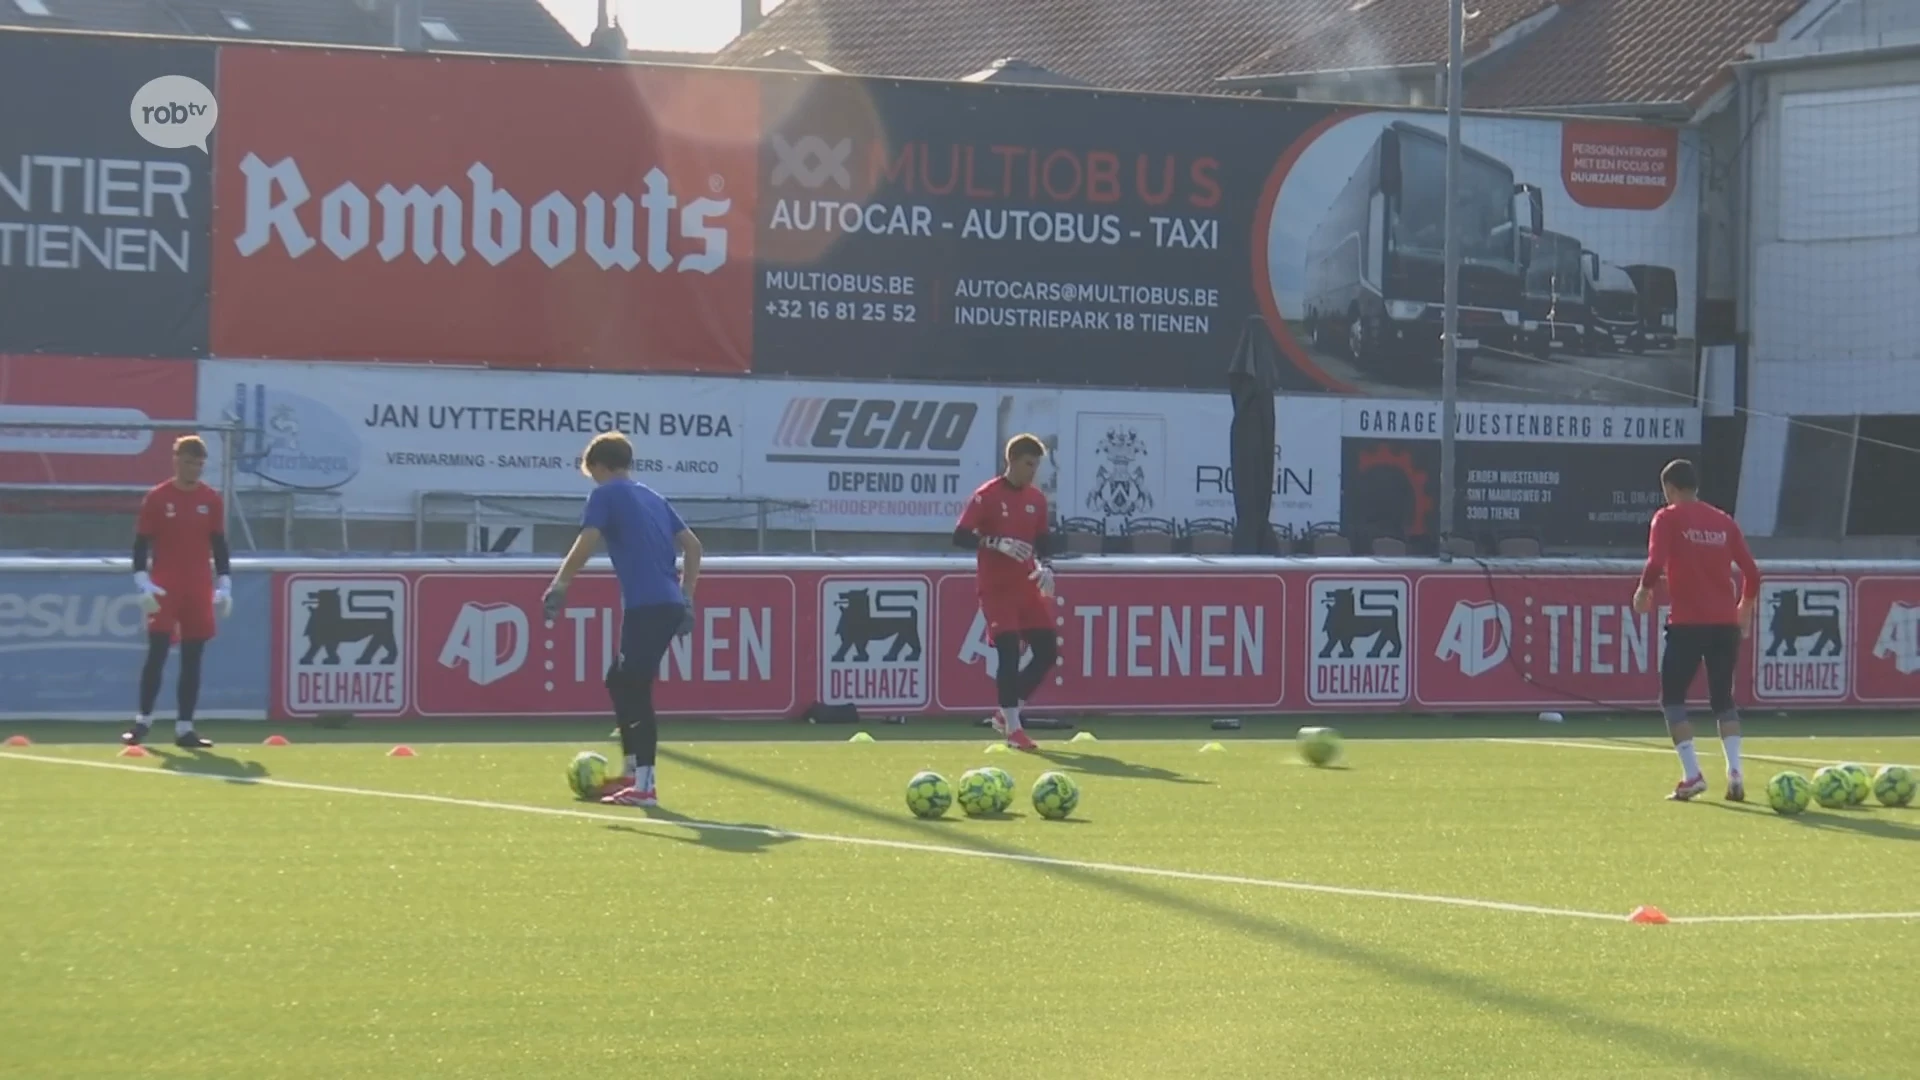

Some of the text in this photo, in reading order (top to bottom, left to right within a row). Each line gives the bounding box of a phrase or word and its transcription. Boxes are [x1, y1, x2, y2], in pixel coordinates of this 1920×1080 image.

[1570, 172, 1667, 187] DUURZAME ENERGIE
[1574, 158, 1594, 169] MET
[1617, 160, 1649, 172] FOCUS
[1651, 161, 1664, 172] OP
[234, 151, 731, 275] Rombouts
[770, 198, 932, 237] AUTOCAR
[961, 208, 1121, 245] AUTOBUS
[1149, 217, 1218, 249] TAXI
[0, 221, 190, 273] TIENEN
[766, 271, 914, 295] MULTIOBUS.BE
[954, 279, 1219, 307] AUTOCARS@MULTIOBUS.BE
[765, 300, 916, 323] +32 16 81 25 52
[954, 306, 1209, 334] INDUSTRIEPARK 18 TIENEN
[365, 404, 733, 438] JAN UYTTERHAEGEN BVBA
[811, 398, 978, 451] ECHO
[1360, 410, 1437, 433] GARAGE
[1603, 418, 1613, 438] &
[1624, 417, 1685, 438] ZONEN
[386, 452, 485, 467] VERWARMING
[497, 455, 562, 469] SANITAIR
[675, 460, 719, 474] AIRCO
[828, 471, 960, 494] DEPEND ON IT
[1466, 488, 1486, 501] SINT
[1491, 507, 1520, 520] TIENEN
[437, 601, 771, 686] AD TINEN
[1074, 605, 1264, 677] TIENEN
[1435, 599, 1512, 677] AD
[298, 671, 396, 704] DELHAIZE
[830, 668, 919, 700] DELHAIZE
[1317, 664, 1400, 695] DELHAIZE
[1764, 662, 1840, 691] DELHAIZE
